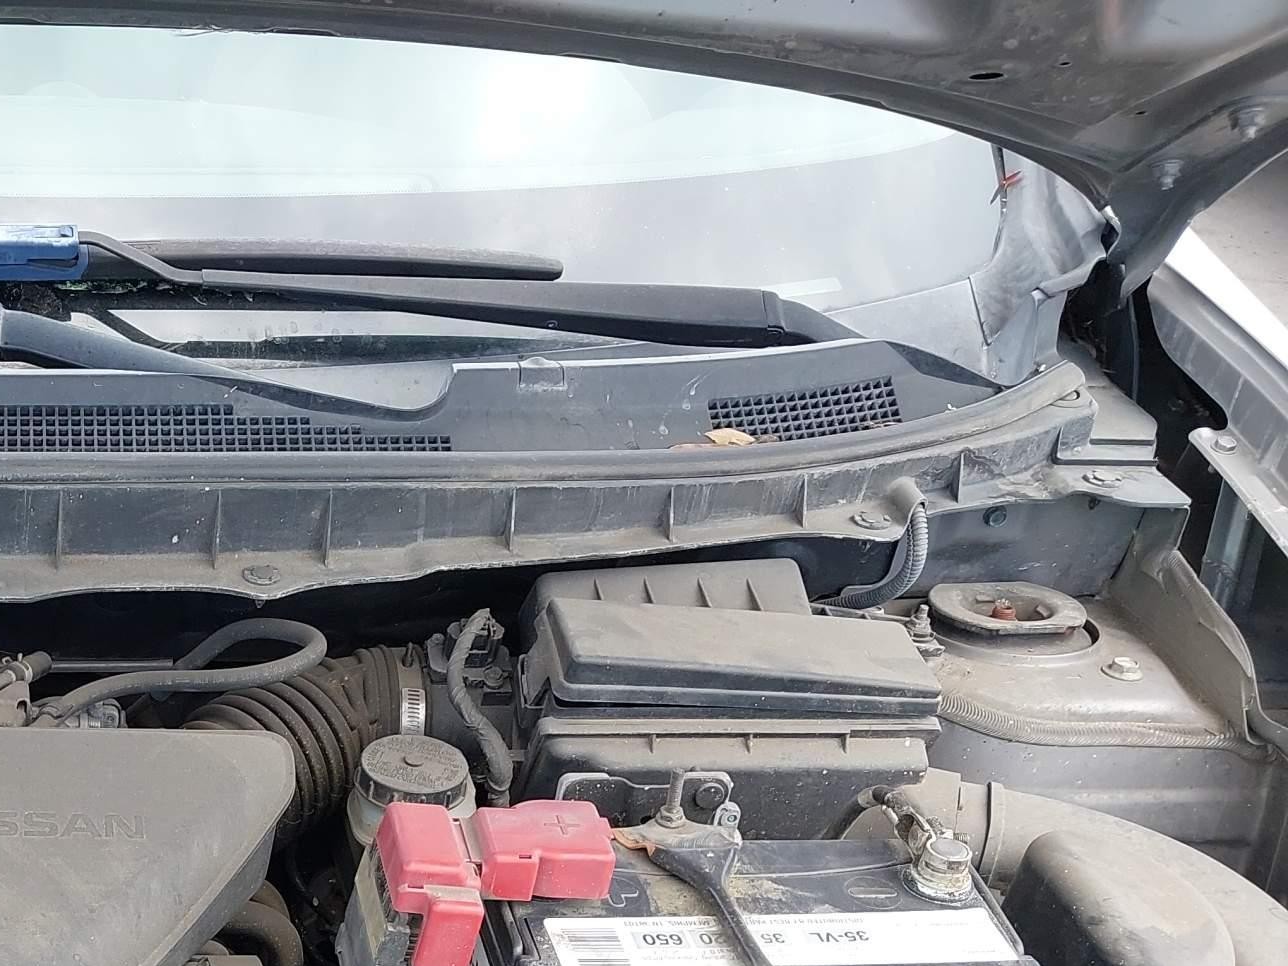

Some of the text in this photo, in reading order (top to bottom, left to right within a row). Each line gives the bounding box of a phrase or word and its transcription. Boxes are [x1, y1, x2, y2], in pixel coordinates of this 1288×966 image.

[643, 933, 683, 946] 650
[760, 933, 786, 944] 35
[808, 931, 869, 943] 35-VL
